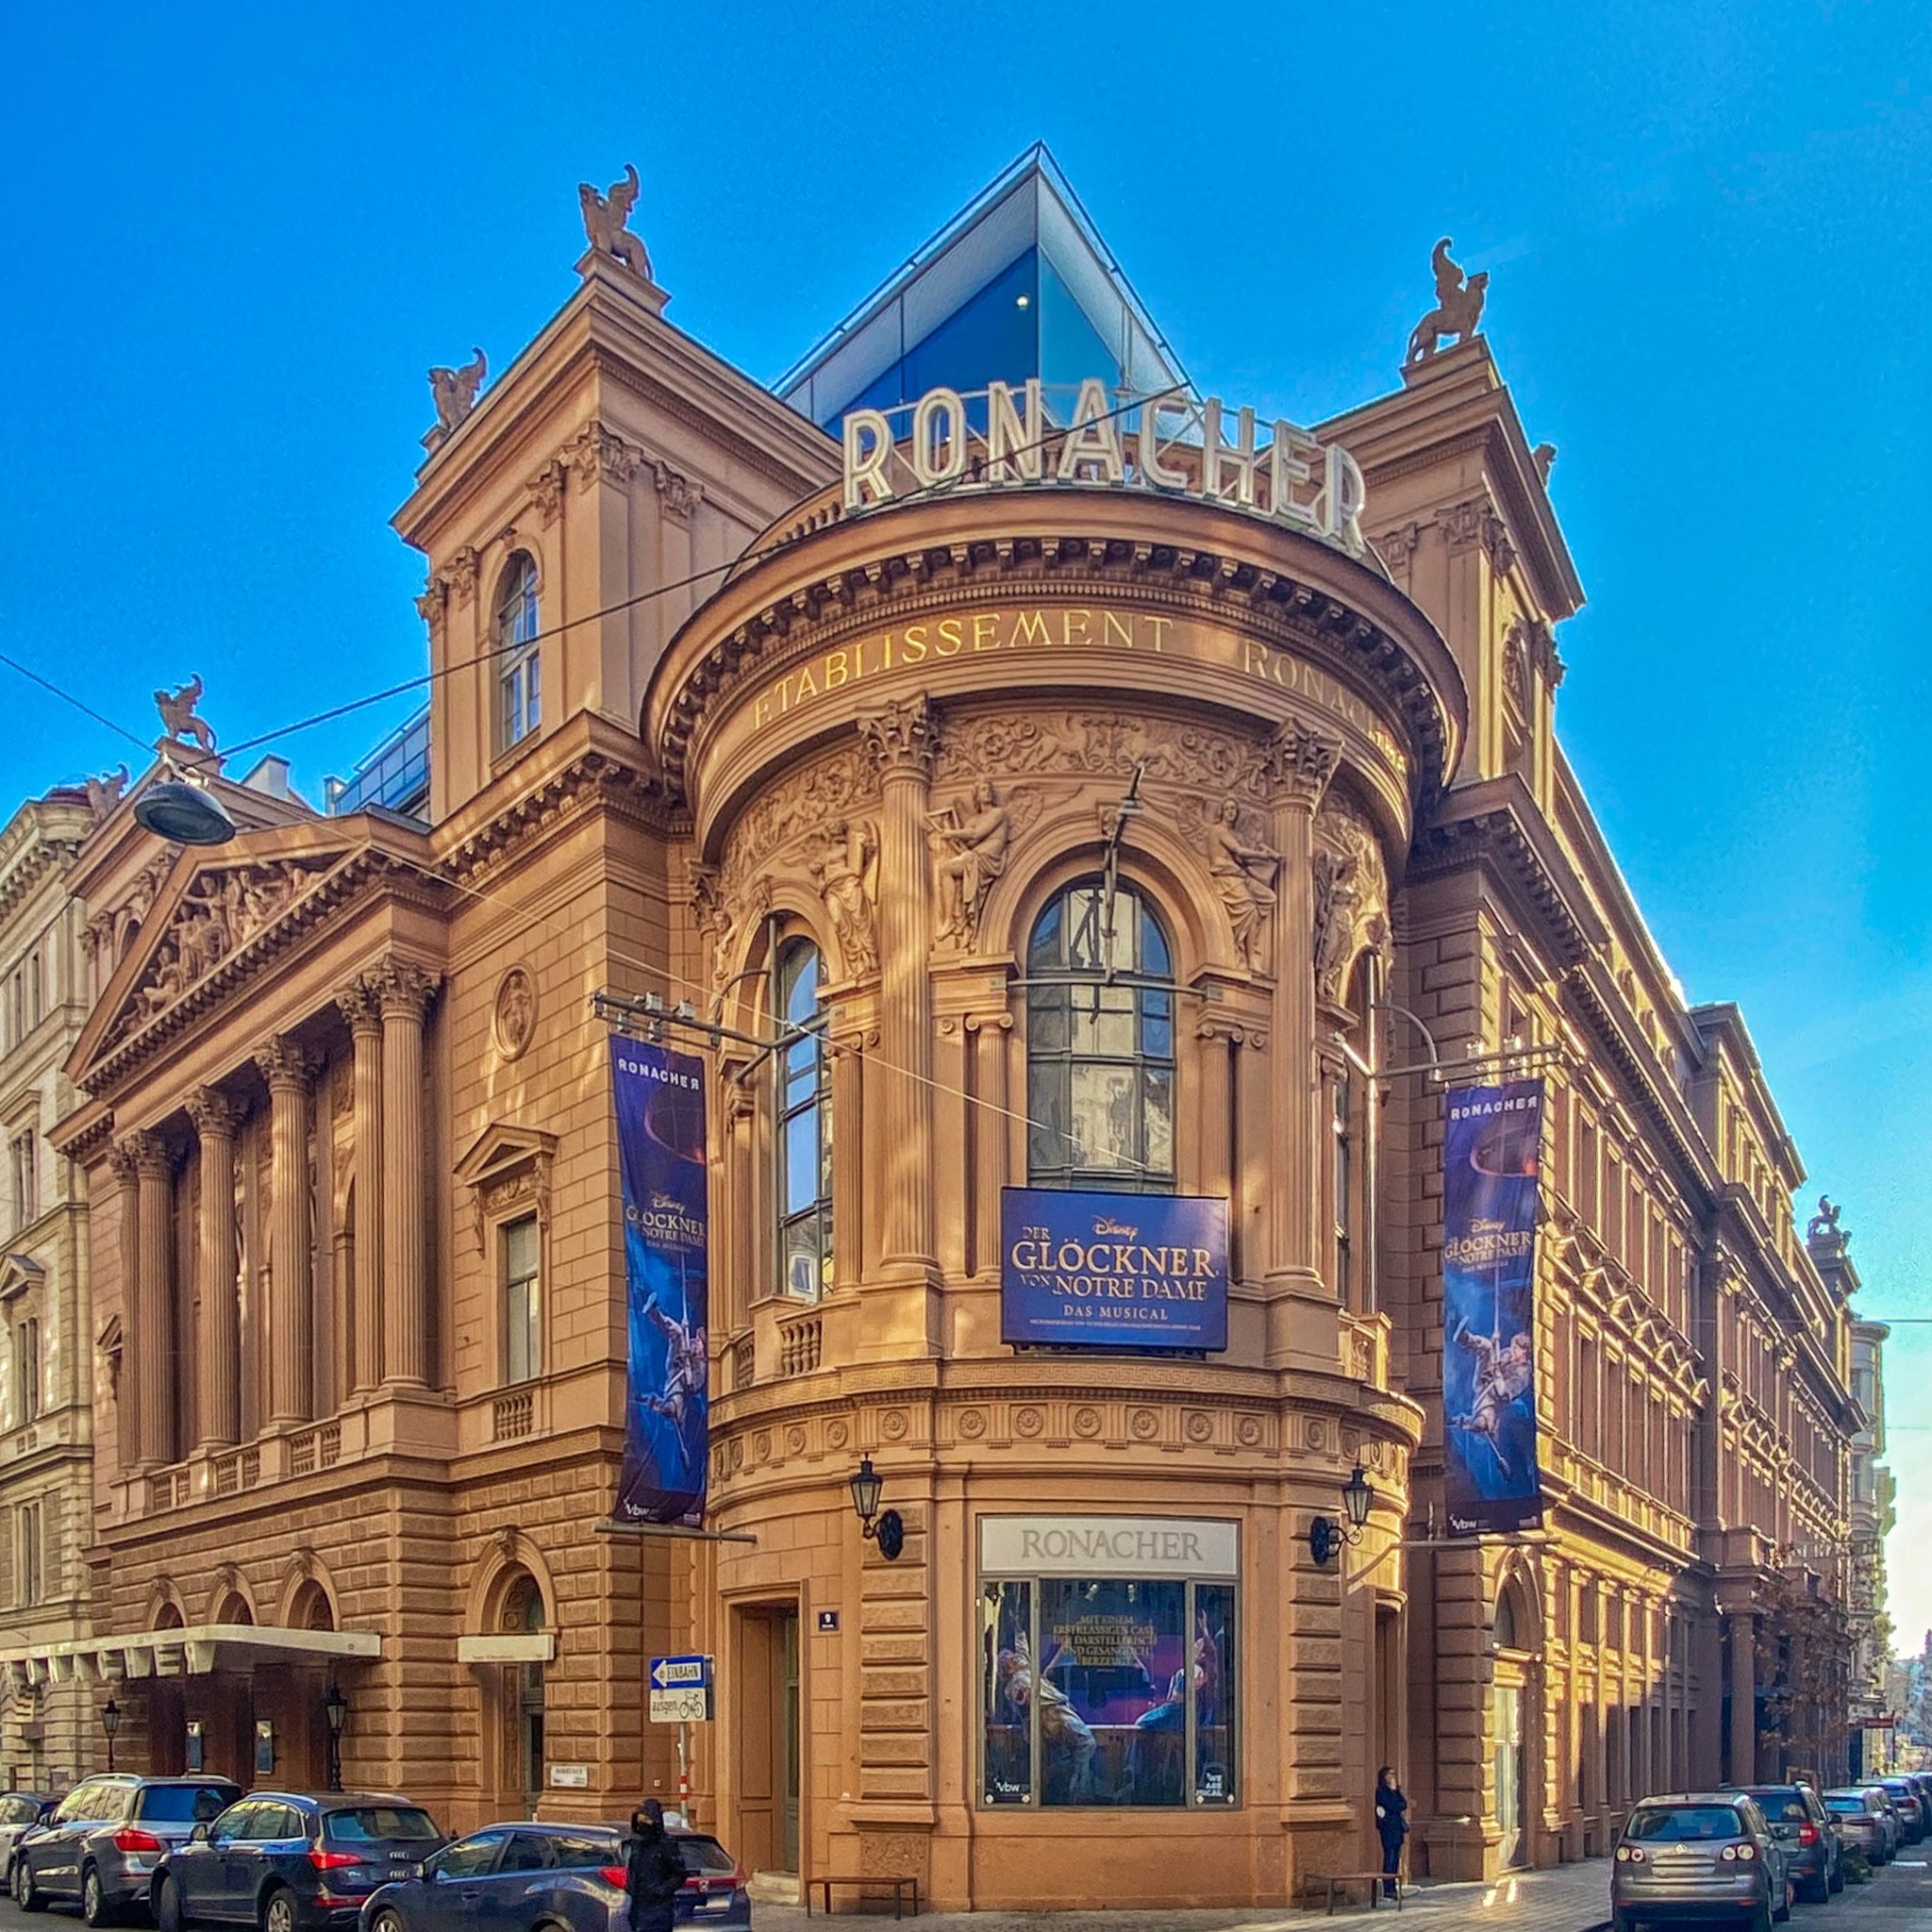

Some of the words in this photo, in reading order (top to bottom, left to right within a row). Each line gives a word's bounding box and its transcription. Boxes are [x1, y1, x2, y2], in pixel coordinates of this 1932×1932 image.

[843, 378, 1366, 560] RONACHER
[755, 609, 1172, 729] ETABLISSEMENT
[1244, 640, 1407, 774] RONAC
[618, 1058, 700, 1091] RONACHER
[1450, 1095, 1538, 1121] RONACHER
[1022, 1226, 1051, 1241] DER
[1091, 1215, 1139, 1241] Disney
[1011, 1238, 1219, 1278] GLÖCKNER
[1020, 1274, 1051, 1288] VON
[1052, 1275, 1134, 1299] NOTRE
[1142, 1278, 1208, 1302] DAME
[1063, 1304, 1092, 1318] DAS
[1099, 1306, 1169, 1322] MUSICAL
[1022, 1530, 1204, 1561] RONACHER
[667, 1664, 699, 1679] EINBAHN
